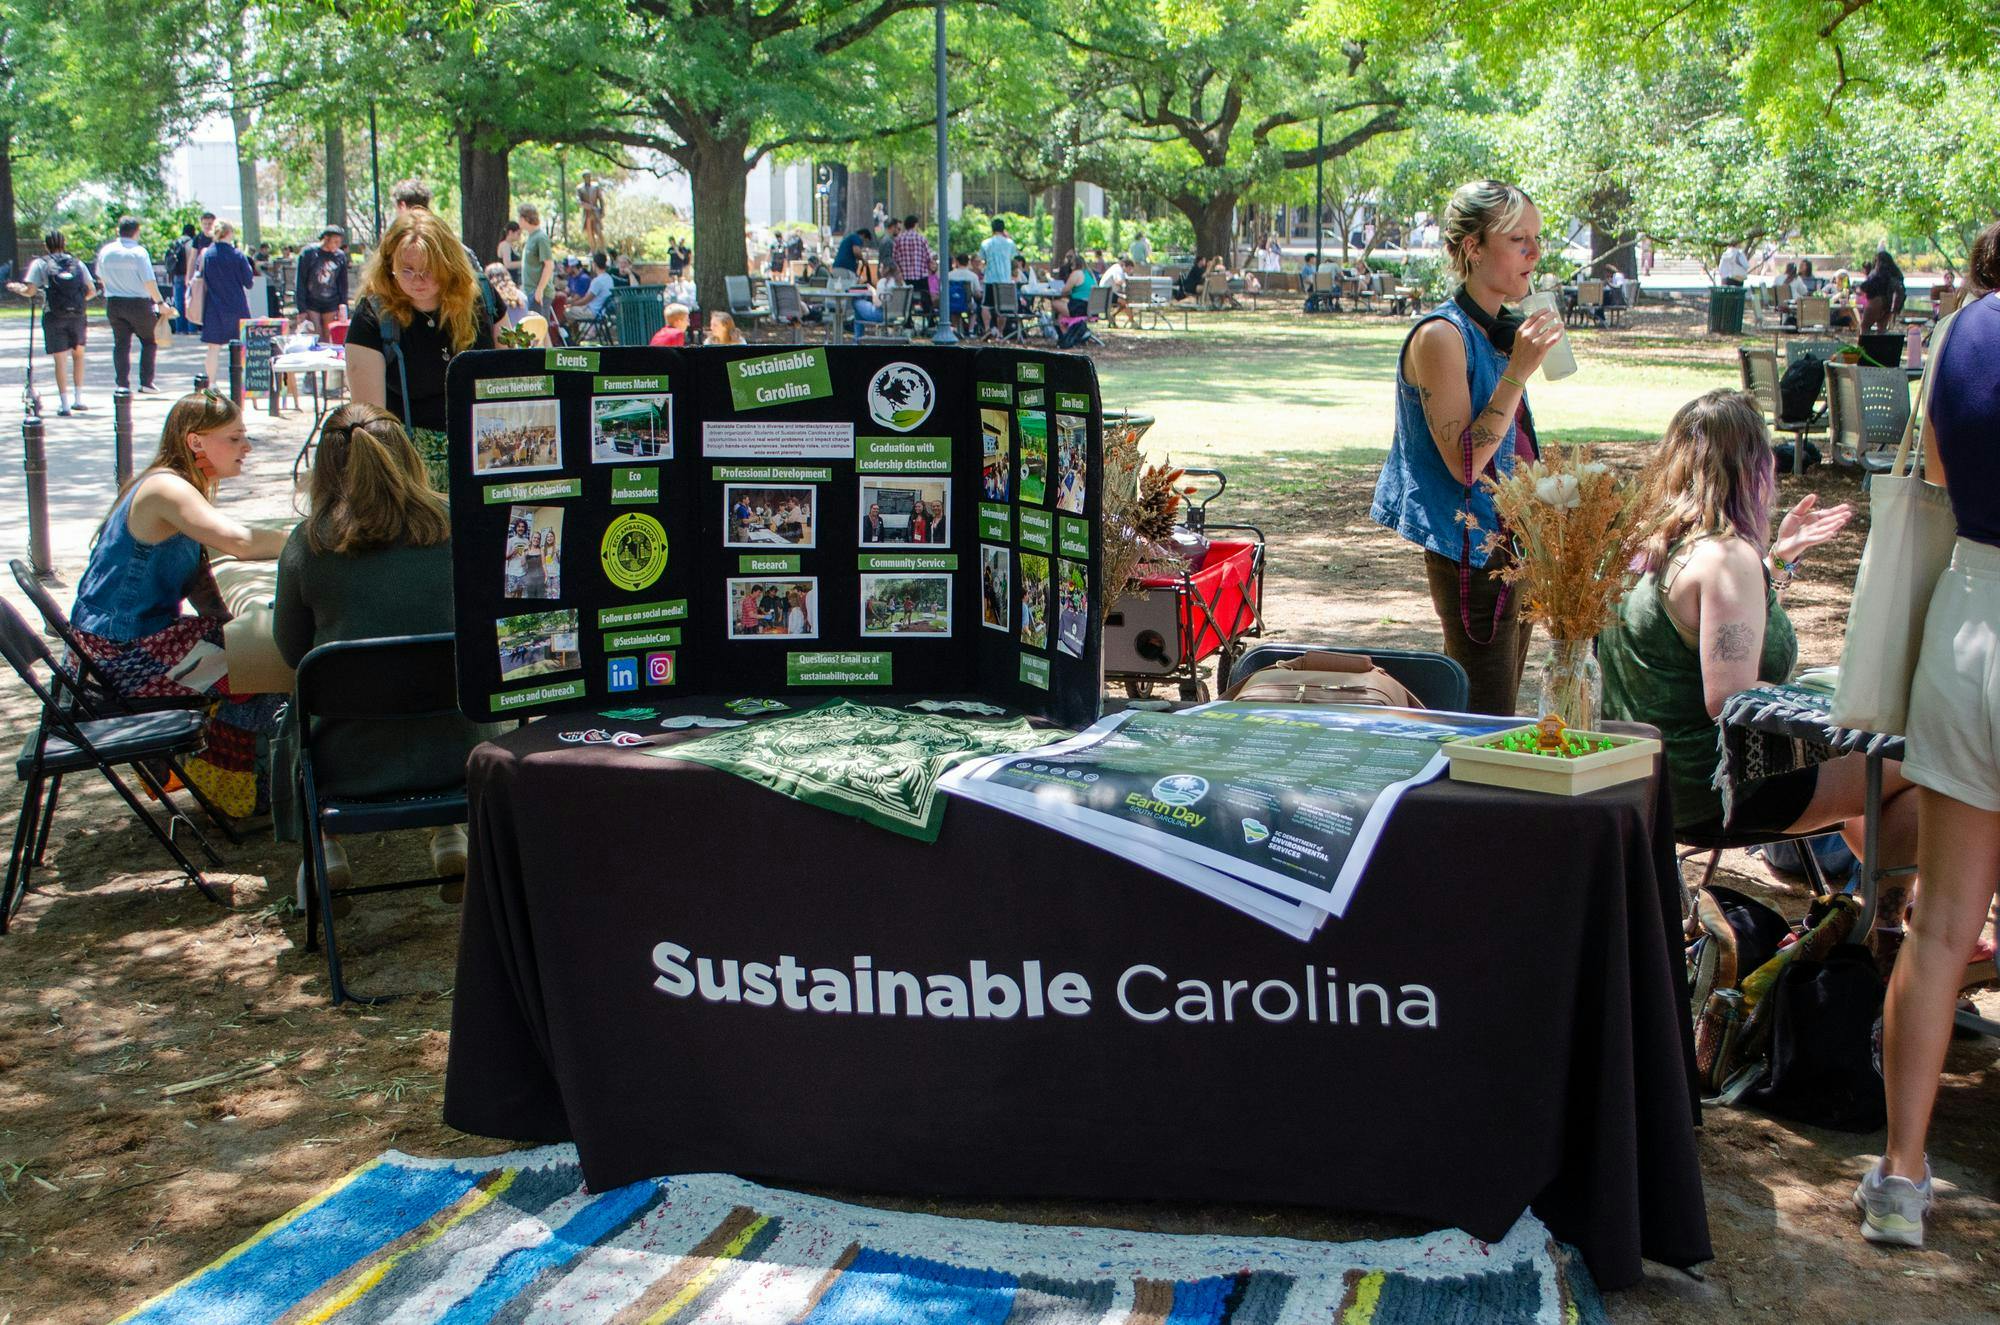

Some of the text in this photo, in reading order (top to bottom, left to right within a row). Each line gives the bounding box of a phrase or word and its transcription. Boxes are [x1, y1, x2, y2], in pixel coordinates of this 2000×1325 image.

[248, 327, 277, 337] FREE
[556, 354, 588, 367] Events
[739, 353, 815, 379] Sustainable
[1022, 366, 1038, 378] Teams
[487, 381, 543, 394] Green Network
[604, 379, 659, 390] Farmers Market
[756, 383, 811, 403] Carolina
[1062, 397, 1084, 409] Zero Waste
[870, 443, 935, 453] Graduation with
[860, 459, 947, 471] Leadership distinction
[629, 471, 641, 481] Eco
[720, 468, 827, 481] Professional Development
[492, 484, 572, 500] Earth Day Celebration
[612, 488, 658, 498] Ambassadors
[981, 507, 1008, 521] Environmental
[1066, 522, 1079, 534] Green
[613, 524, 656, 548] ECO AMBASSADOR
[1061, 538, 1086, 553] Certification
[752, 560, 787, 570] Research
[870, 558, 945, 569] Community Service
[602, 606, 684, 624] Follow us on social media!
[613, 632, 671, 648] @SustainableCaro
[799, 655, 839, 665] Questions?
[841, 655, 861, 664] Email
[872, 656, 880, 664] at
[612, 664, 633, 687] in
[800, 672, 878, 682] sustainability@sc.edu
[501, 684, 575, 706] Events and Outreach
[1125, 792, 1207, 828] Earth Day
[1129, 805, 1187, 829] SOUTH CAROLINA
[1282, 833, 1317, 849] DEPARTMENT
[1267, 842, 1301, 859] SERVICES
[1271, 836, 1329, 862] ENVIRONMENTAL
[652, 941, 1438, 1029] Sustainable Carolina
